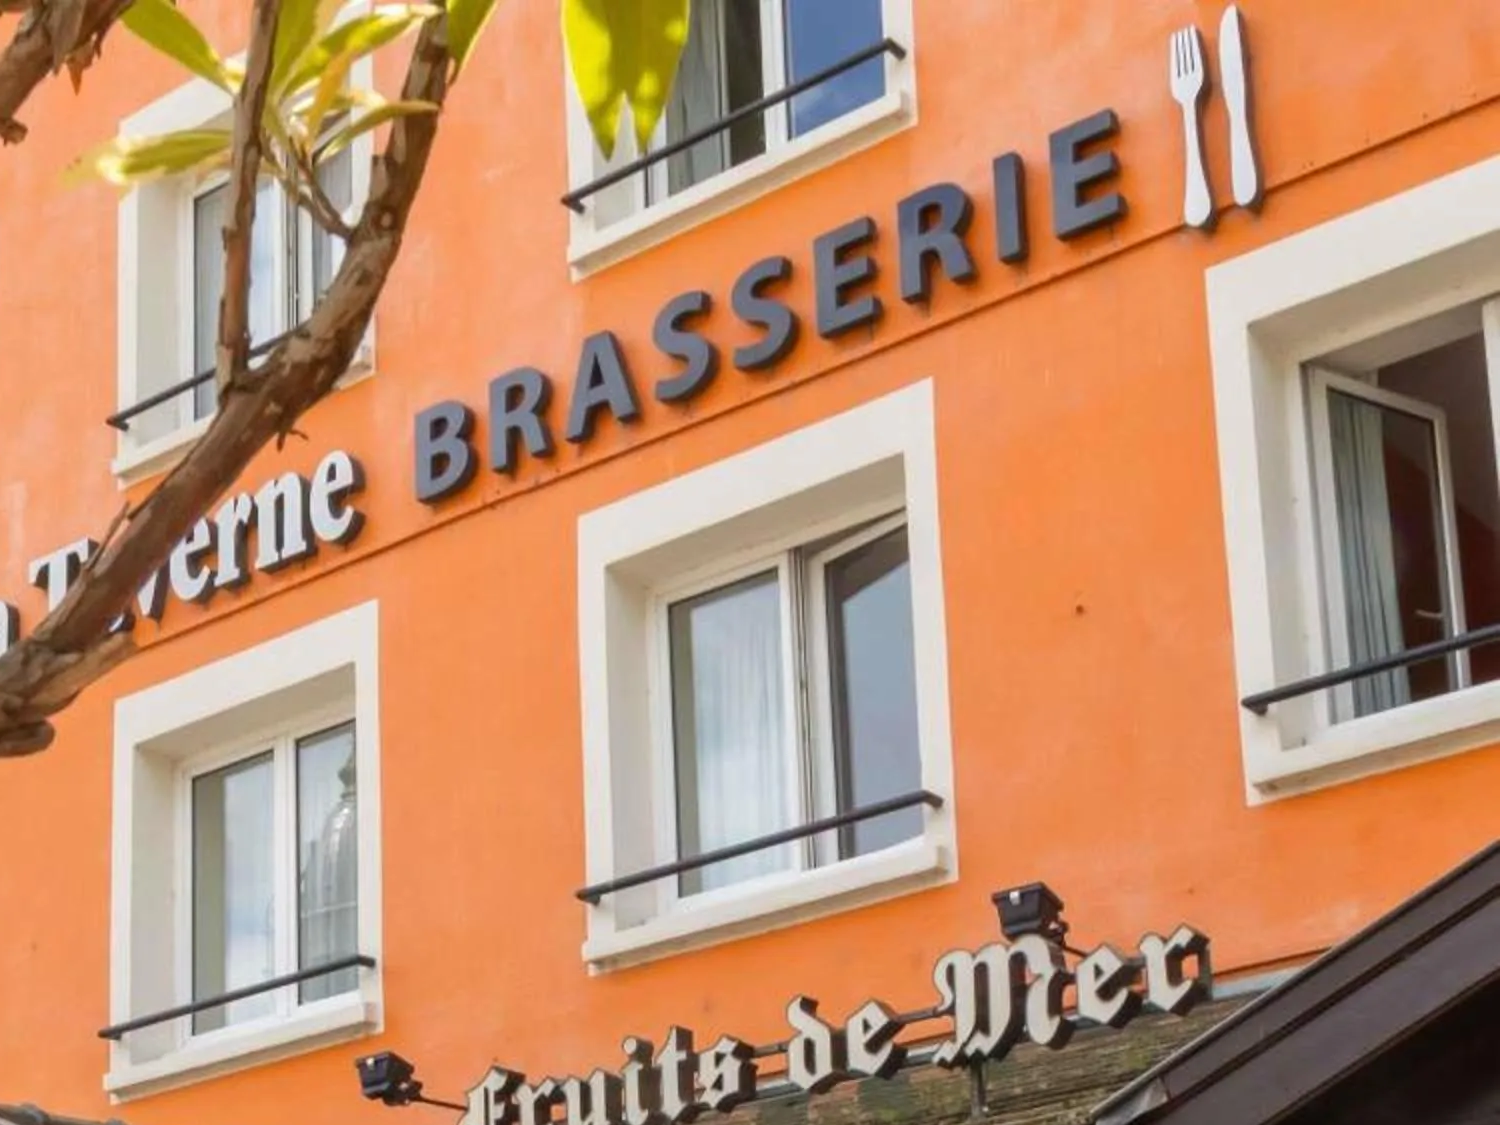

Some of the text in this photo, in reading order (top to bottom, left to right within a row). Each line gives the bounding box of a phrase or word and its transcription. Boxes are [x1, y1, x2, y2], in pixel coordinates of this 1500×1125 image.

[414, 108, 1128, 506] BRASSERIE
[787, 994, 907, 1095] de
[934, 924, 1216, 1068] Mer
